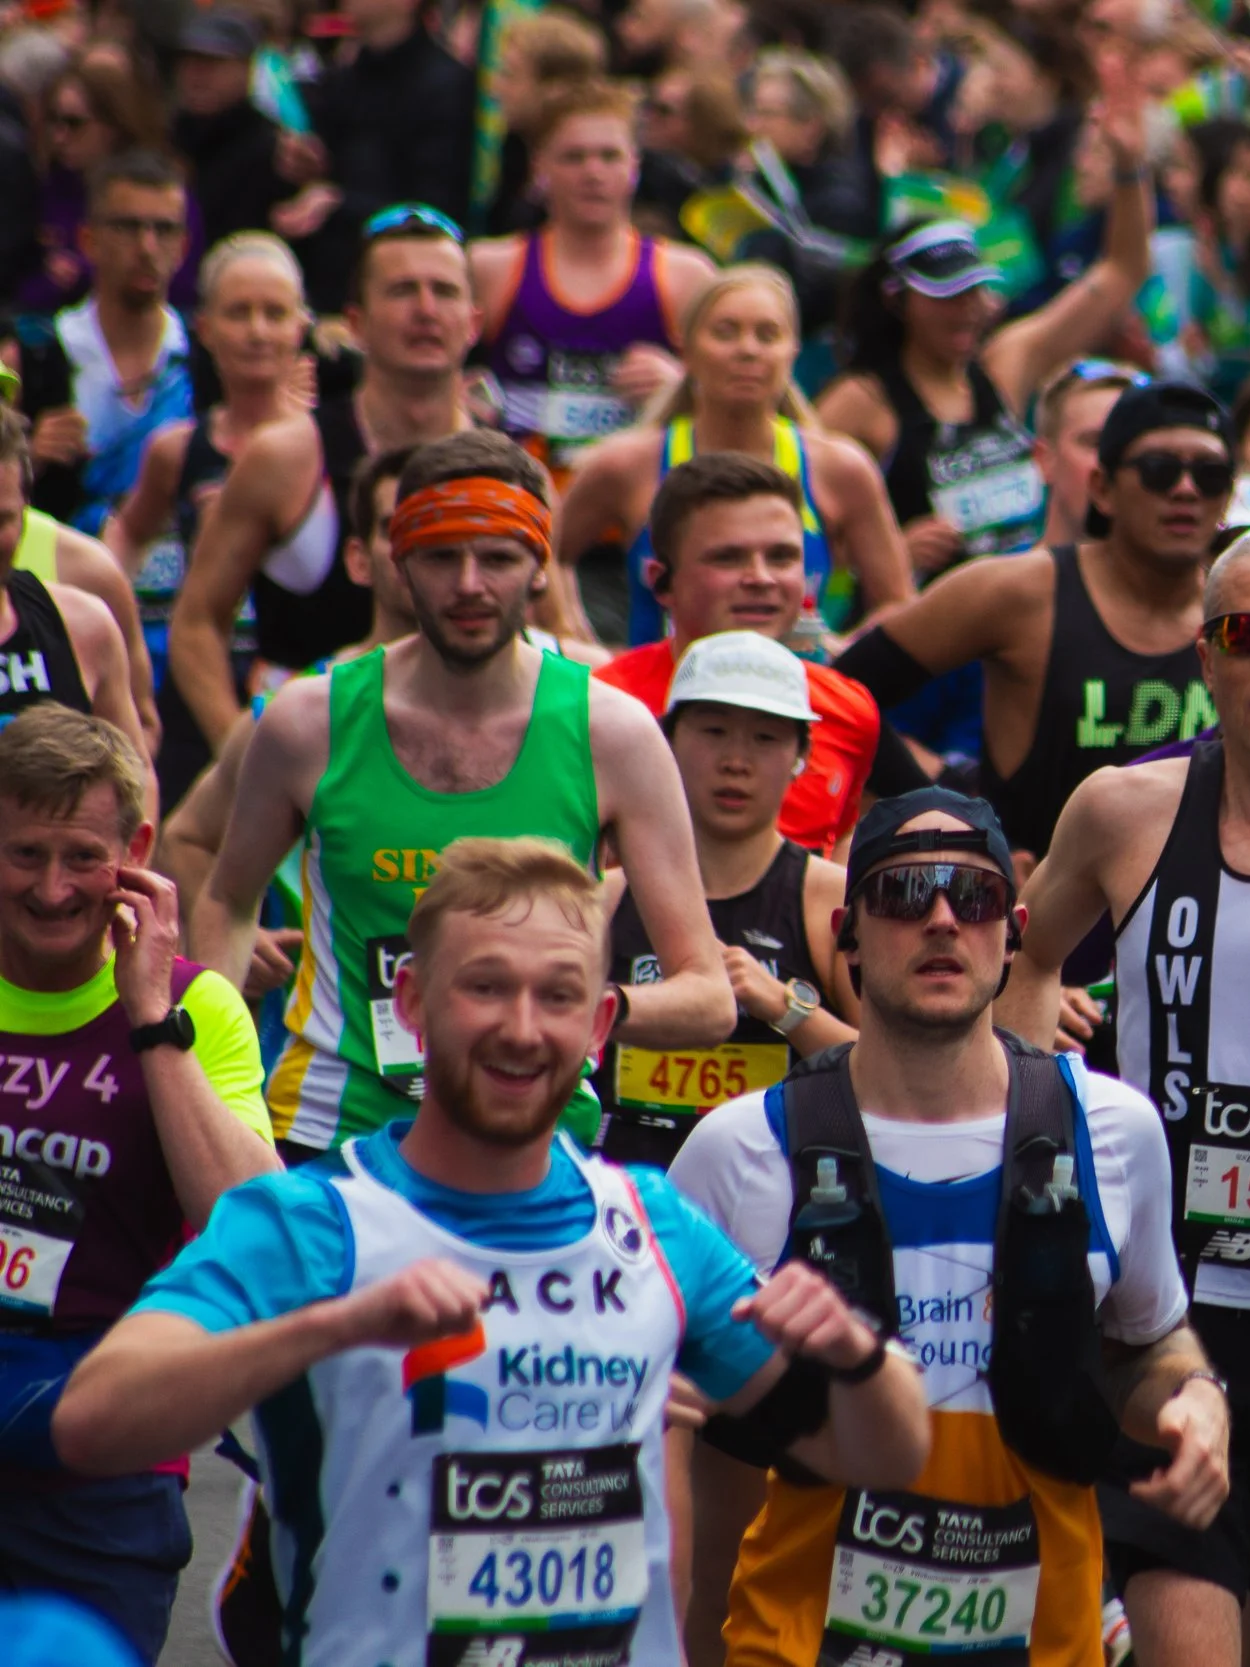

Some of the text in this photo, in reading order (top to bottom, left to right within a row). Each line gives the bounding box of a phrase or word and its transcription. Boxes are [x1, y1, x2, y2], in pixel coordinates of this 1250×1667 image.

[1155, 896, 1203, 1121] OWLS
[0, 1054, 119, 1110] zy 4
[649, 1055, 746, 1099] 4765
[0, 1241, 36, 1292] 6
[895, 1291, 972, 1324] Brain
[498, 1343, 648, 1398] Kidney
[497, 1391, 600, 1432] Care
[447, 1462, 534, 1520] tcs
[540, 1471, 630, 1500] CONSULTANCY
[542, 1462, 584, 1480] TATA
[540, 1498, 604, 1519] SERVICES
[853, 1489, 925, 1553] tcs
[937, 1510, 983, 1530] TATA
[932, 1546, 1000, 1564] SERVICES
[934, 1525, 1032, 1546] CONSULTANCY
[468, 1541, 614, 1608] 43018
[861, 1571, 1007, 1636] 37240
